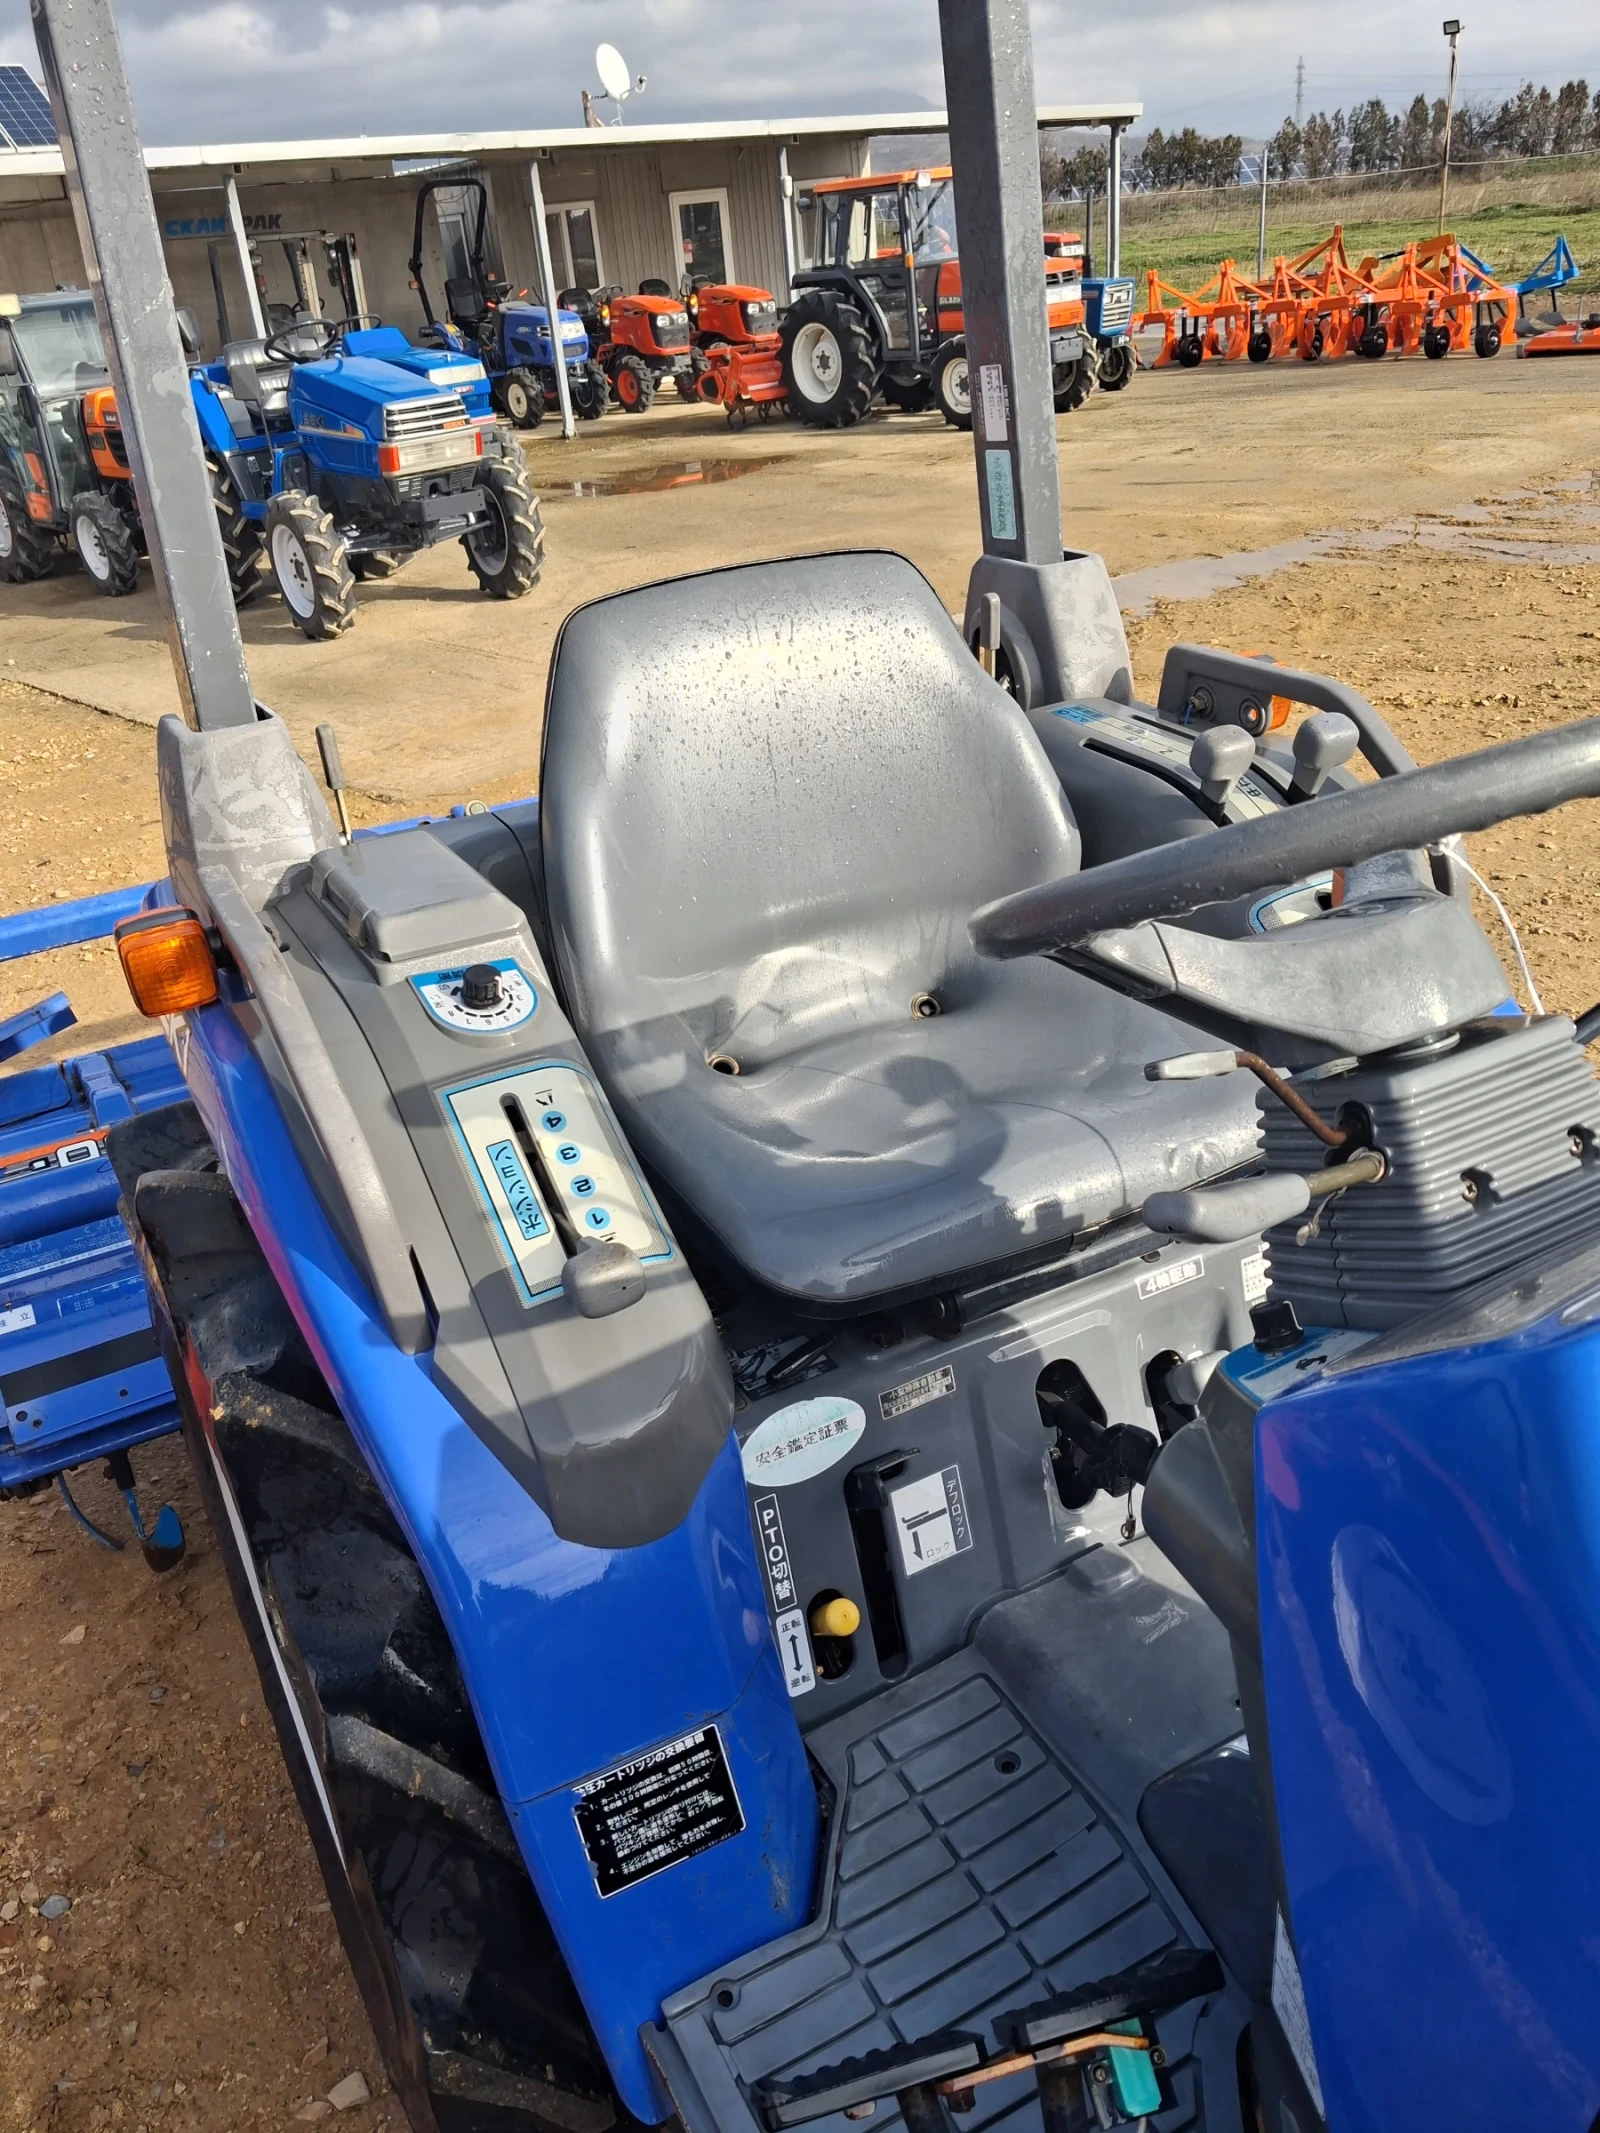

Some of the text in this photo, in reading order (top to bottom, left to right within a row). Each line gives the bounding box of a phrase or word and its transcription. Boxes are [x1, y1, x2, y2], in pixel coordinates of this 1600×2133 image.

[546, 1116, 562, 1128] 4
[560, 1146, 577, 1161] 3
[494, 1145, 542, 1234] ポジション
[574, 1178, 592, 1193] 2
[591, 1212, 605, 1225] 1
[755, 1417, 850, 1467] 安全鑑定証票
[946, 1480, 965, 1539] デフロック
[762, 1508, 792, 1600] PTO切替
[926, 1541, 950, 1559] ロック
[781, 1617, 802, 1633] 正転
[790, 1673, 812, 1689] 逆転
